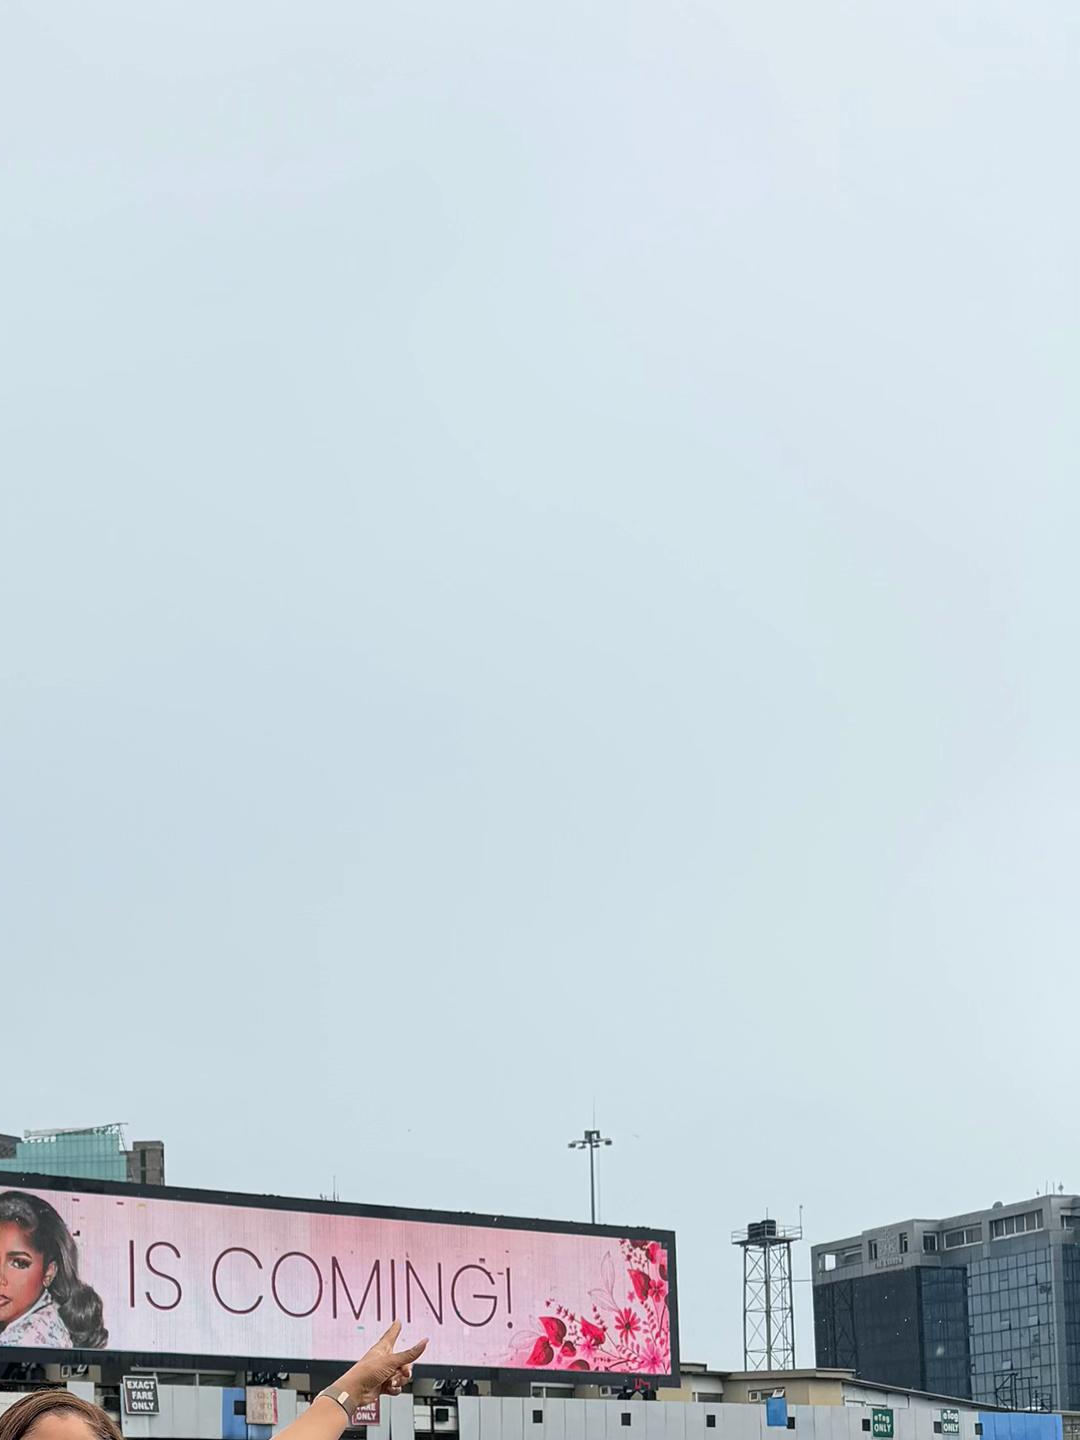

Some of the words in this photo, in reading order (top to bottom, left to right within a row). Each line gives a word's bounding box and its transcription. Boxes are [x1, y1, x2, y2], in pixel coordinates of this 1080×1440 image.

[129, 1240, 182, 1311] IS
[211, 1246, 514, 1329] COMING!
[126, 1380, 155, 1390] EXACT
[132, 1391, 154, 1400] FARE
[132, 1401, 154, 1410] ONLY
[356, 1411, 377, 1420] ONLY
[874, 1424, 892, 1432] ONLY
[943, 1423, 958, 1432] ONLY
